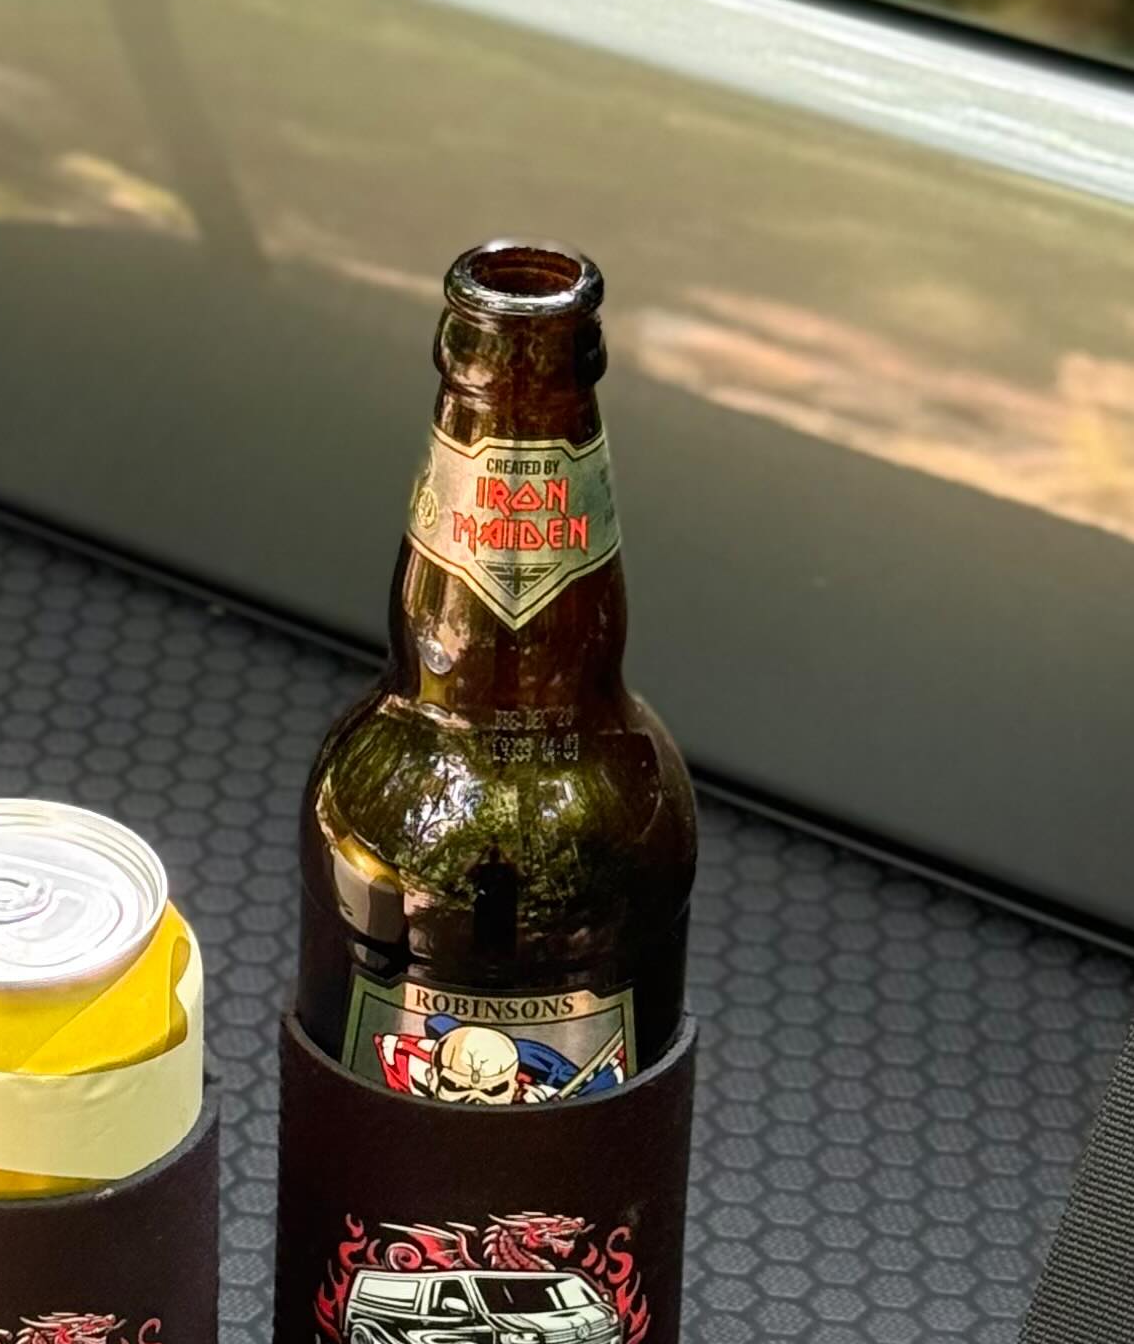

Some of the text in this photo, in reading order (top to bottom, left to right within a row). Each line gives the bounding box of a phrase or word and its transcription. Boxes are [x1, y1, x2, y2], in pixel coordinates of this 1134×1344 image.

[486, 457, 560, 475] CREATED BY
[475, 476, 569, 518] IRON
[452, 510, 588, 556] MAIDEN
[415, 988, 575, 1020] ROBINSONS
